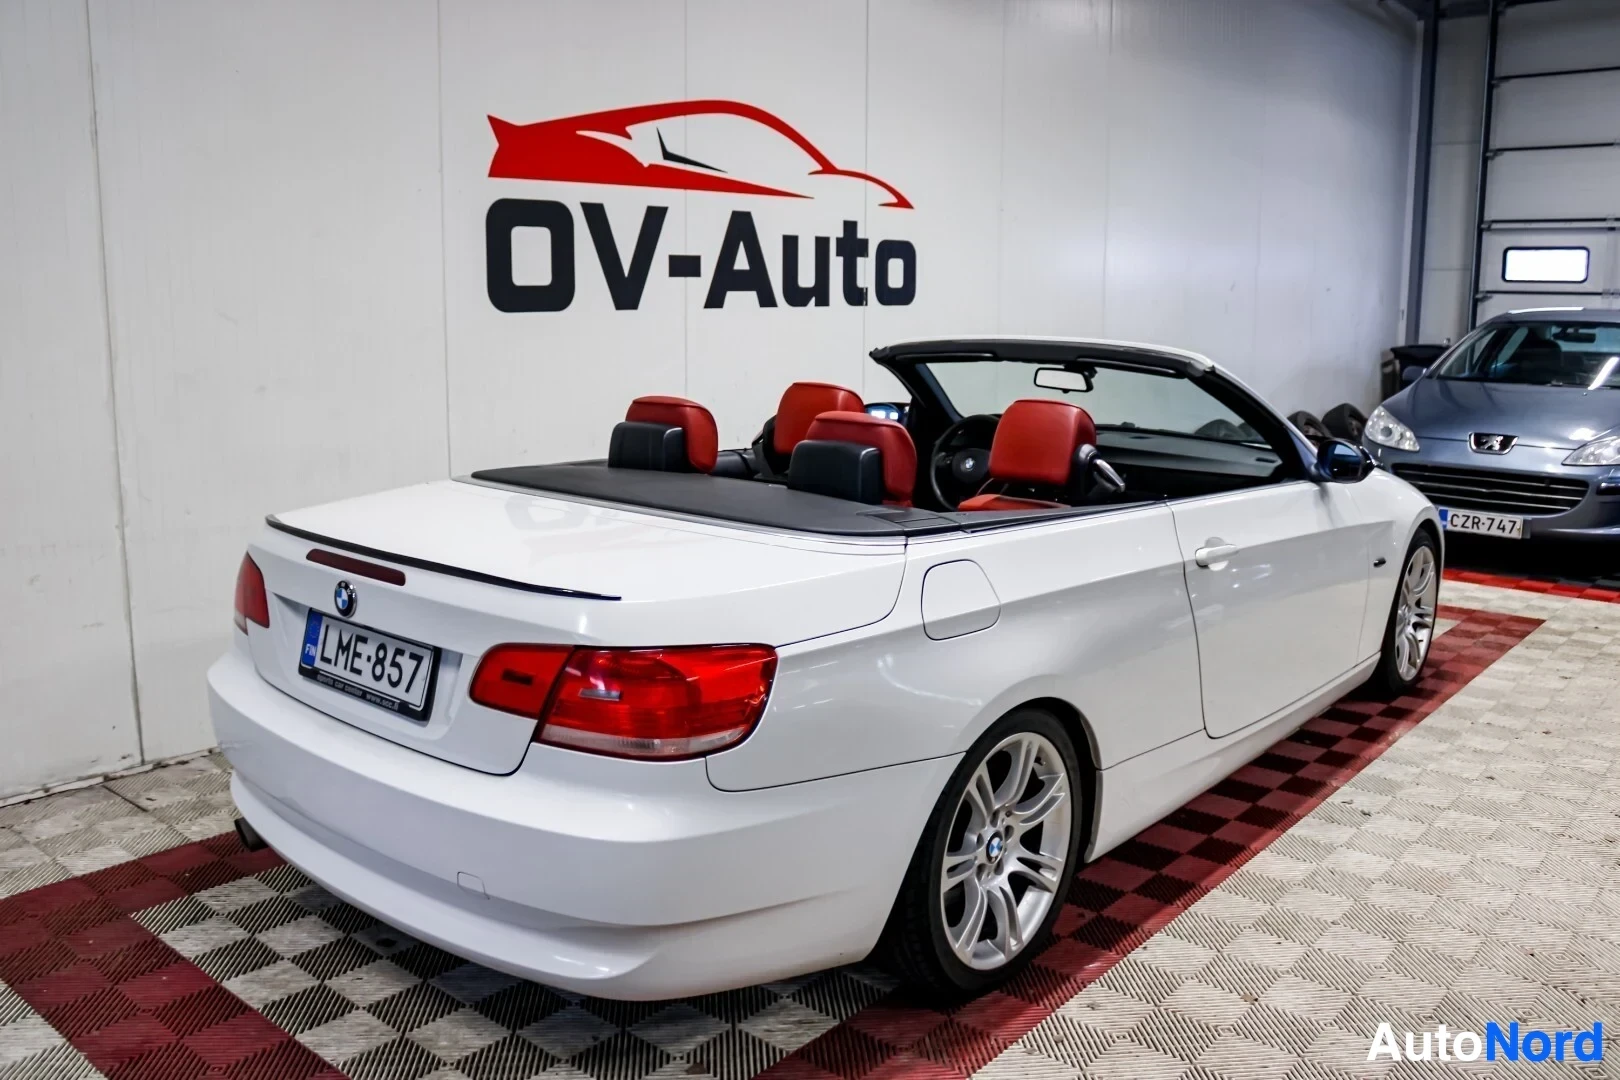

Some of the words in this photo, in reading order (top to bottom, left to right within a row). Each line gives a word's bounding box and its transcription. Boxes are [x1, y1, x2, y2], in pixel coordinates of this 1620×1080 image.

[485, 198, 917, 313] OV-Auto
[1450, 513, 1517, 534] CZR-747
[304, 643, 317, 656] FIN
[320, 624, 424, 694] LME-857
